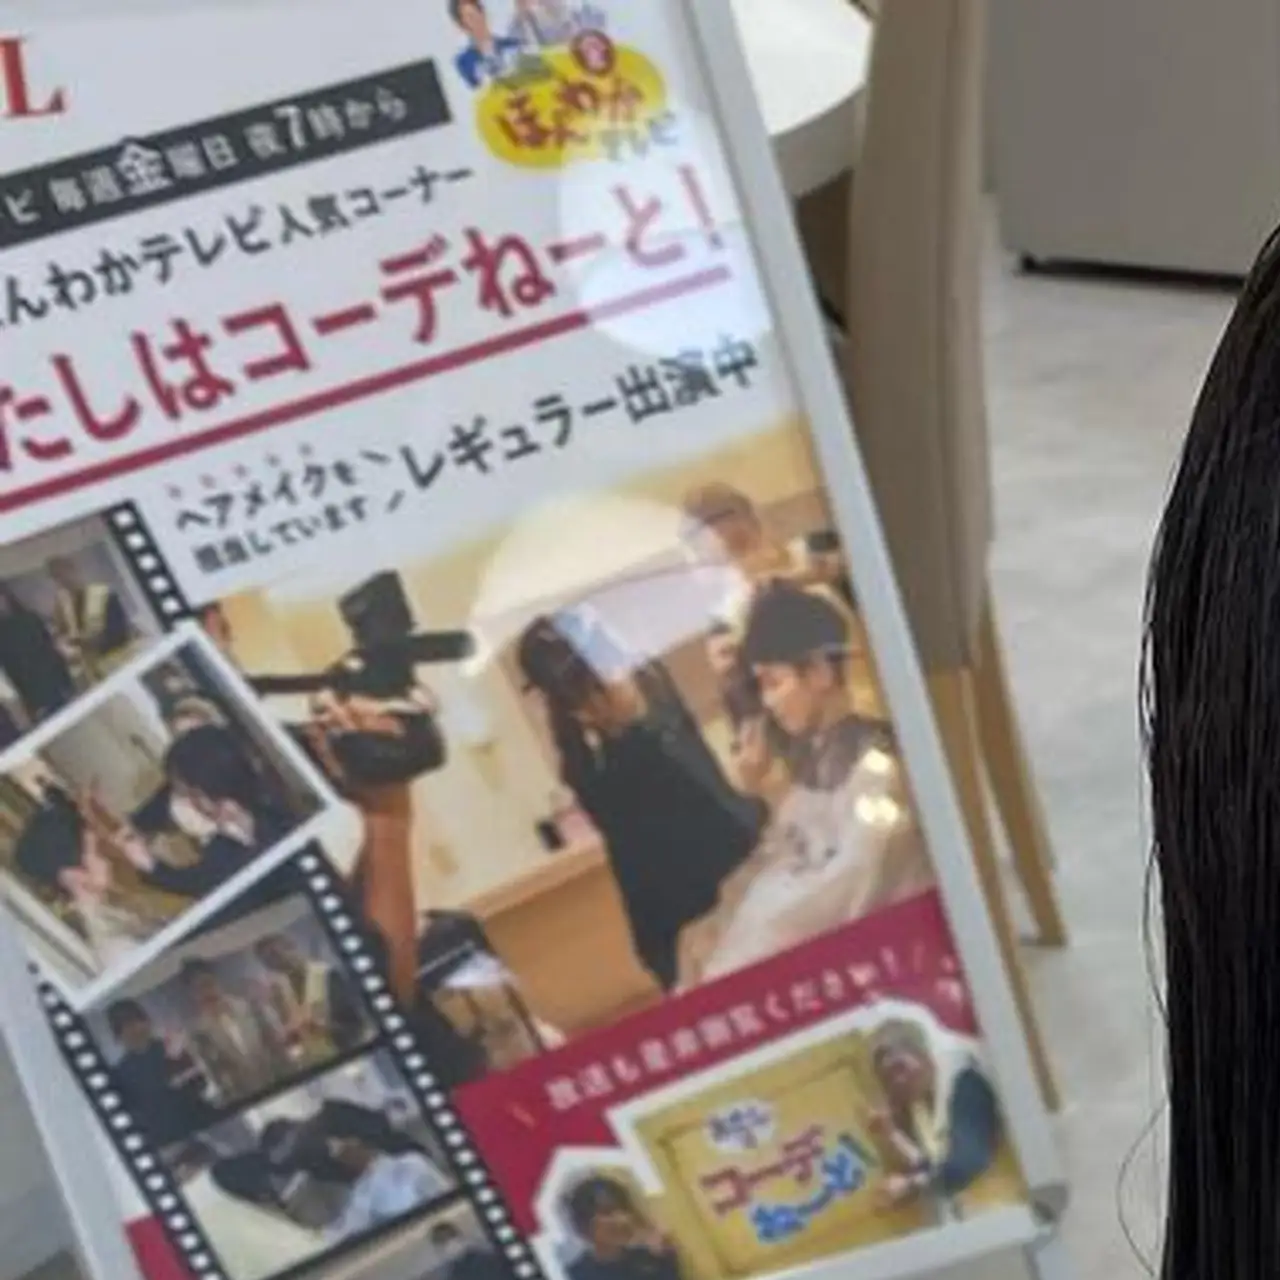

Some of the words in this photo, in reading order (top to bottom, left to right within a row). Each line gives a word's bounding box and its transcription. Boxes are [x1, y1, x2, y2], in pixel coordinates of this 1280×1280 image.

[0, 166, 473, 326] んわかテレビ人気コーナー
